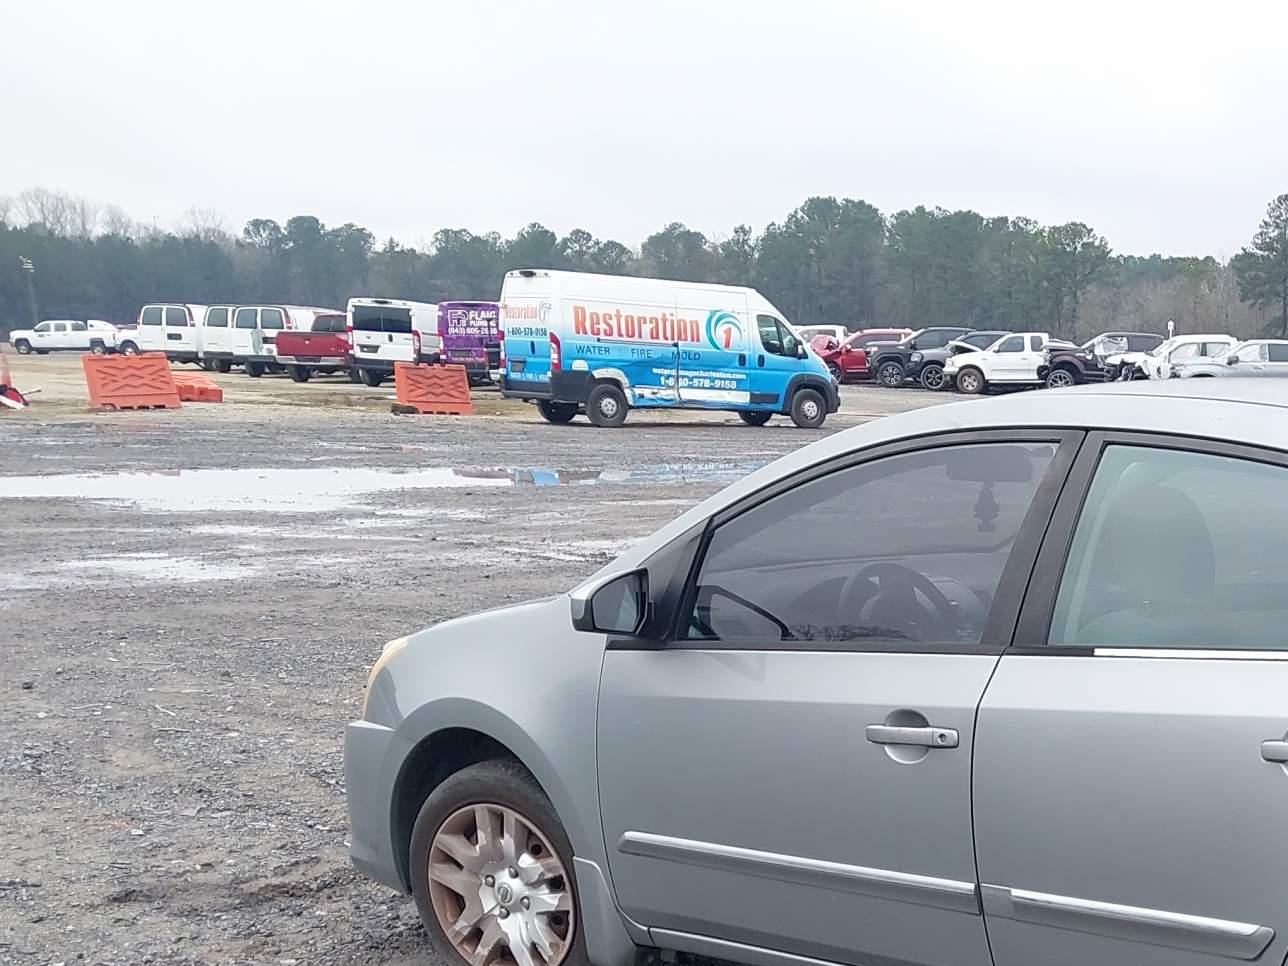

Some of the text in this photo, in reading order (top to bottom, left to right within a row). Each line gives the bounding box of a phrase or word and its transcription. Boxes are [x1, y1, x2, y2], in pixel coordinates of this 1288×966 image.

[573, 304, 733, 348] Restoration 1
[575, 345, 701, 361] WATER FIRE MOLD
